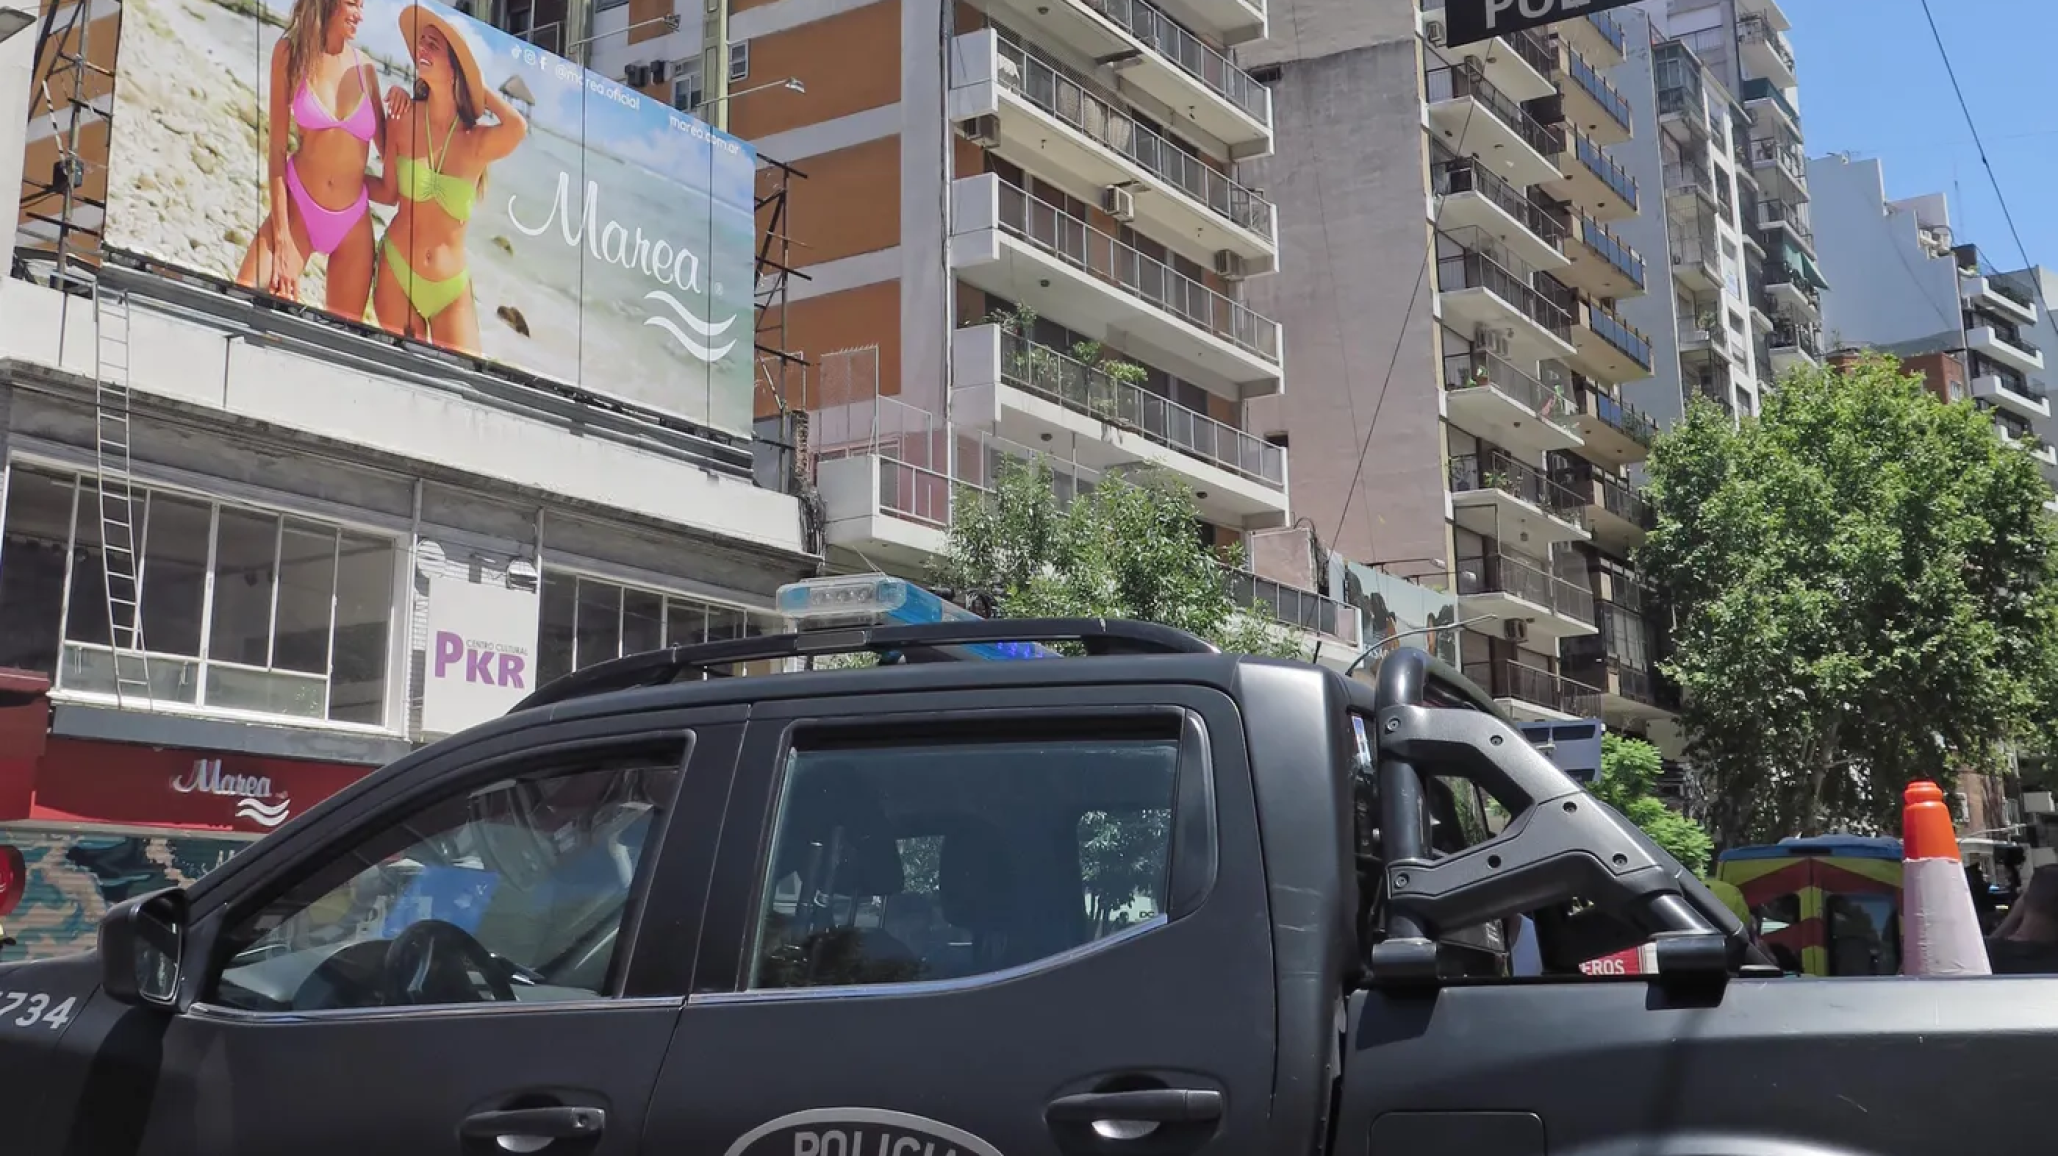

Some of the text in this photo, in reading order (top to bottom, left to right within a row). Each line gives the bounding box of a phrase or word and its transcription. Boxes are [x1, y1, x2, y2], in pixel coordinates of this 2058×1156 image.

[555, 64, 640, 110] @marea.oficial
[669, 114, 739, 153] marea.com.ar
[508, 171, 701, 293] Marea
[435, 631, 525, 689] PKR
[466, 639, 528, 656] CENTRO CULTURAL
[171, 759, 272, 797] Marea
[1579, 959, 1625, 975] EROS
[0, 991, 77, 1029] 734
